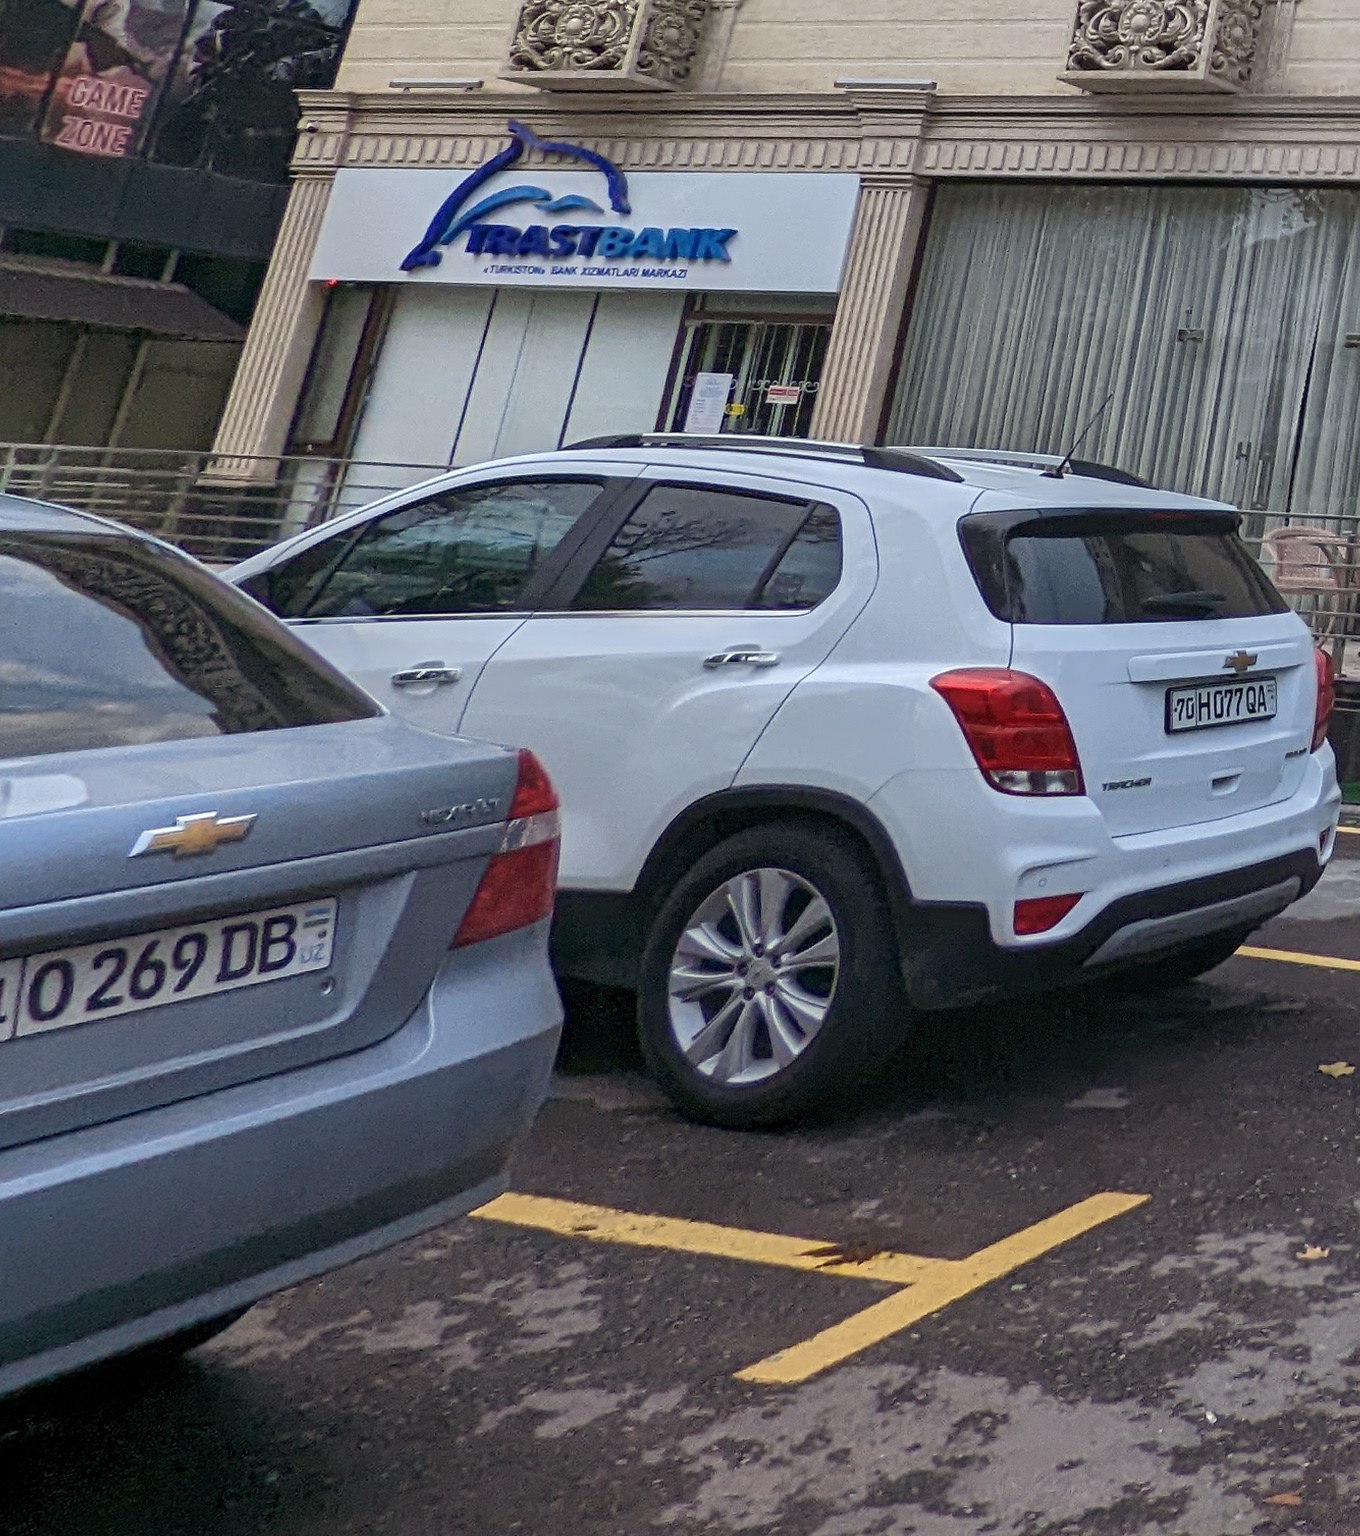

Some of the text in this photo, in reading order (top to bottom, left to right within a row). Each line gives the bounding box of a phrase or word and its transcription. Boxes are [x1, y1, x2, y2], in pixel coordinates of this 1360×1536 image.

[68, 76, 147, 118] GAME
[56, 115, 132, 155] ZONE
[465, 224, 738, 262] TRASTBANK
[551, 266, 579, 275] BANK
[580, 266, 639, 277] XIZMATLARI
[641, 268, 688, 279] MARKAZI
[1174, 697, 1194, 721] 70
[215, 914, 298, 983] DB
